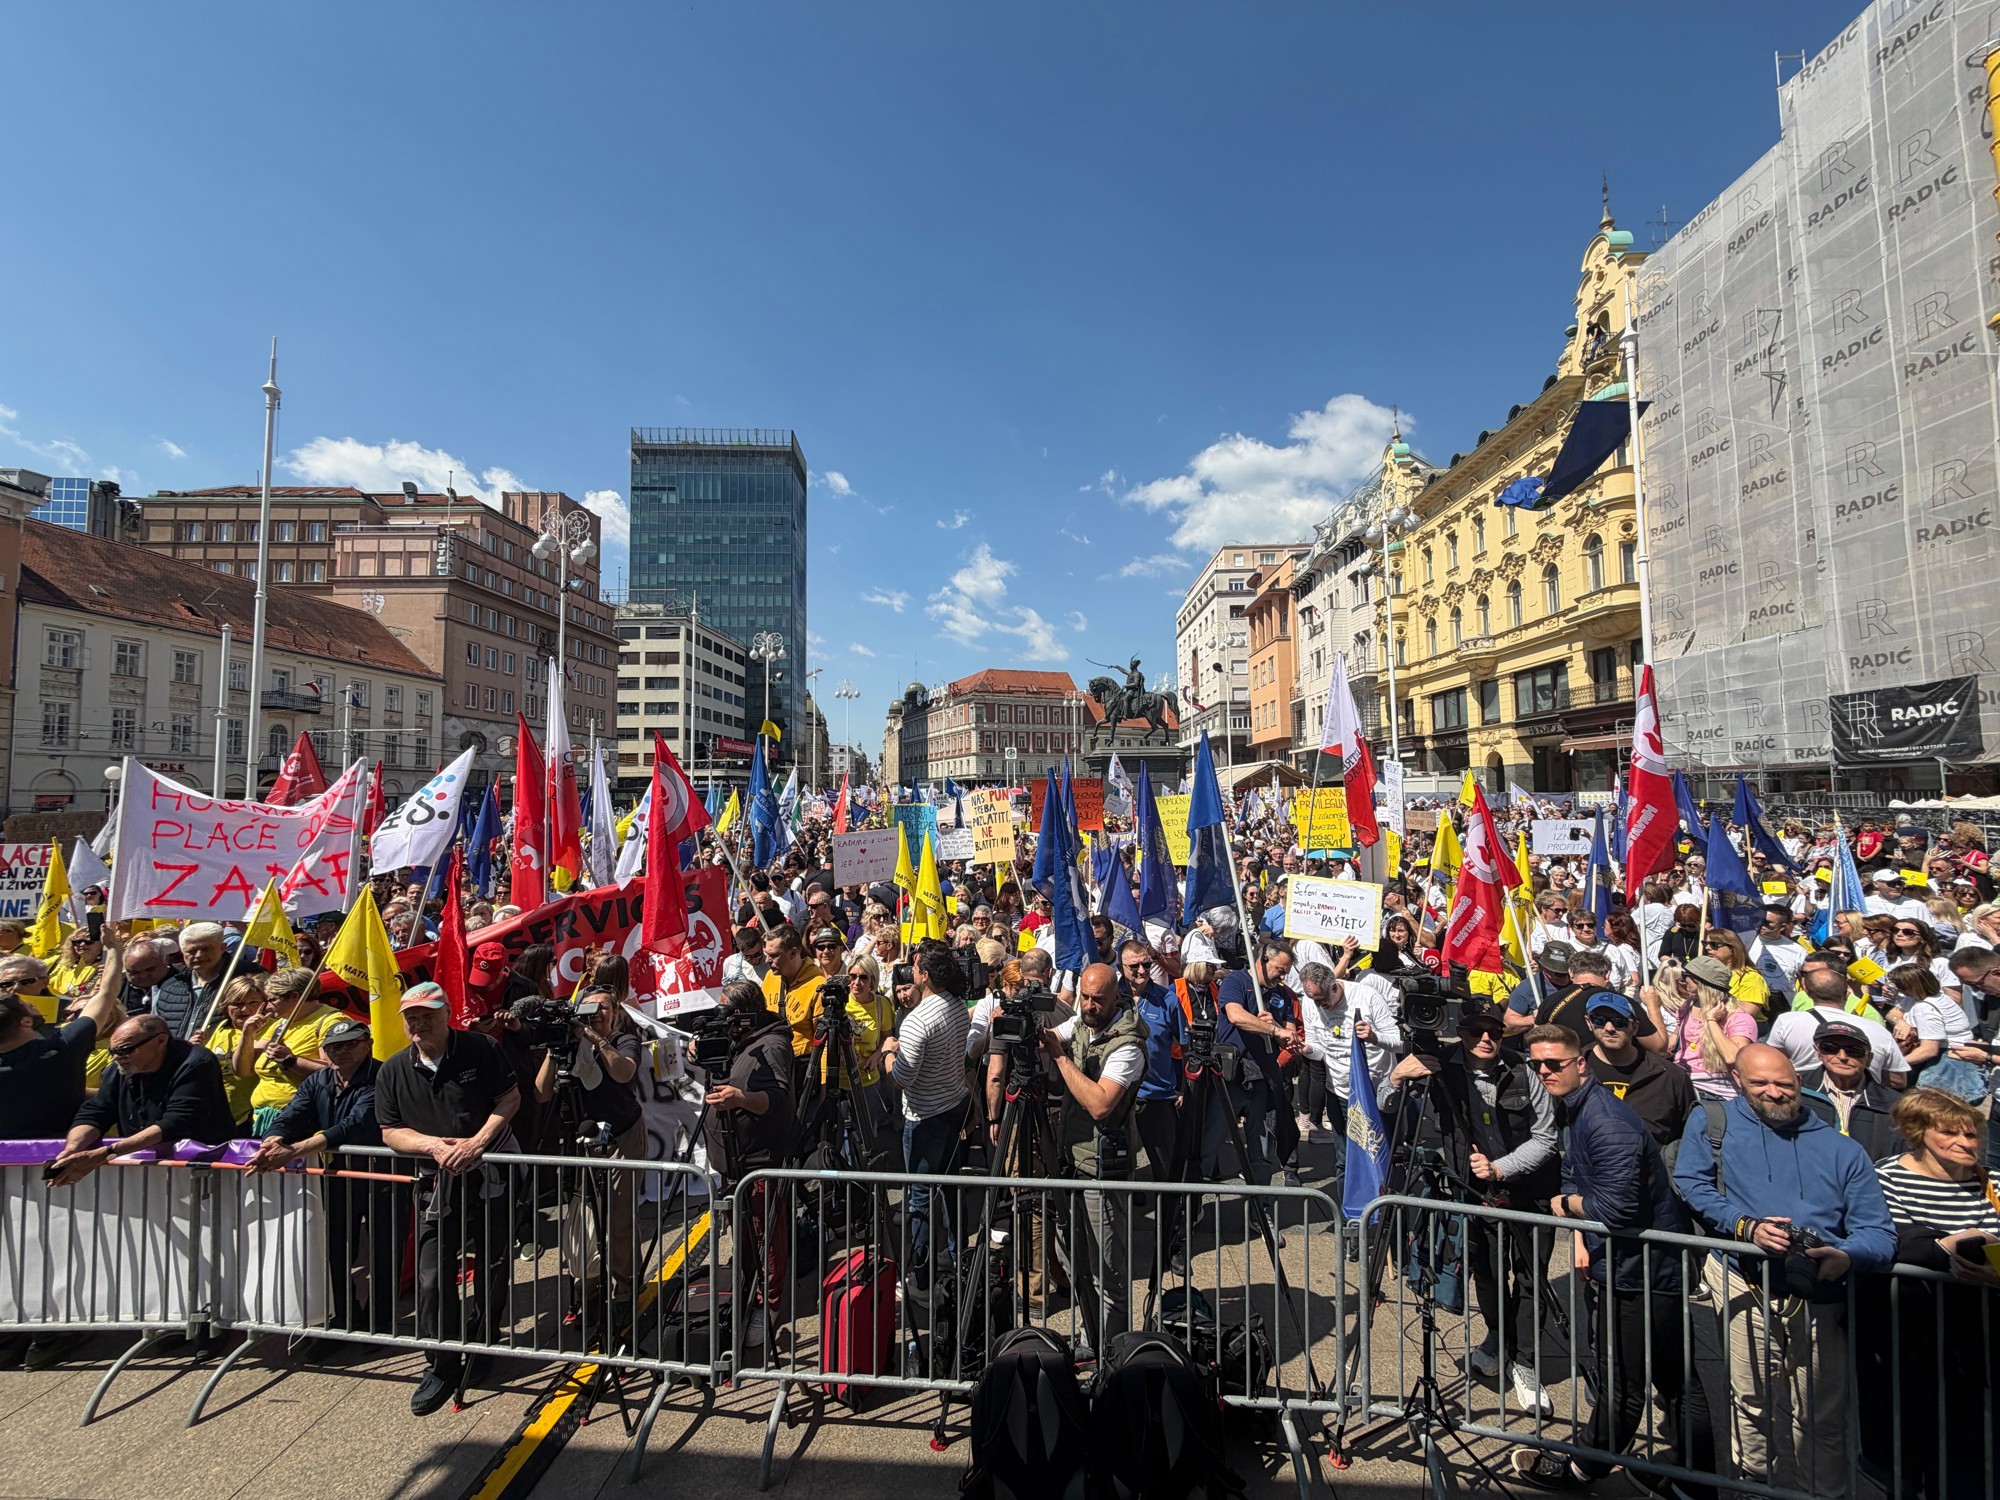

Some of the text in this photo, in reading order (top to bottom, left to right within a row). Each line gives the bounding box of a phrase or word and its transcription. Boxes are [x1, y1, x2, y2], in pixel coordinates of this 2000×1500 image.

[1808, 175, 1869, 227] RADIĆ
[1888, 164, 1957, 223] RADIĆ
[1727, 211, 1769, 254] RADIĆ
[1640, 293, 1674, 325] RADIĆ
[1684, 318, 1720, 354] RADIĆ
[1822, 325, 1884, 371] RADIĆ
[1904, 332, 1977, 380] RADIĆ
[1645, 402, 1680, 431] RADIĆ
[1692, 437, 1730, 466] RADIĆ
[1742, 468, 1787, 497] RADIĆ
[1835, 483, 1899, 518] RADIĆ
[1650, 514, 1686, 539] RADIĆ
[1916, 507, 1992, 544] RADIĆ
[1700, 561, 1739, 582] RADIĆ
[1750, 600, 1796, 622] RADIĆ
[1850, 646, 1912, 670] RADIĆ
[1891, 698, 1960, 721] RADIĆ
[1687, 725, 1725, 741] RADIĆ
[1735, 736, 1776, 751] RADIĆ
[972, 788, 1009, 807] NAS PUN
[974, 804, 996, 816] TREBA
[152, 817, 281, 853] PLAĆE
[982, 826, 994, 838] NE
[1320, 914, 1367, 930] PAŠTETU
